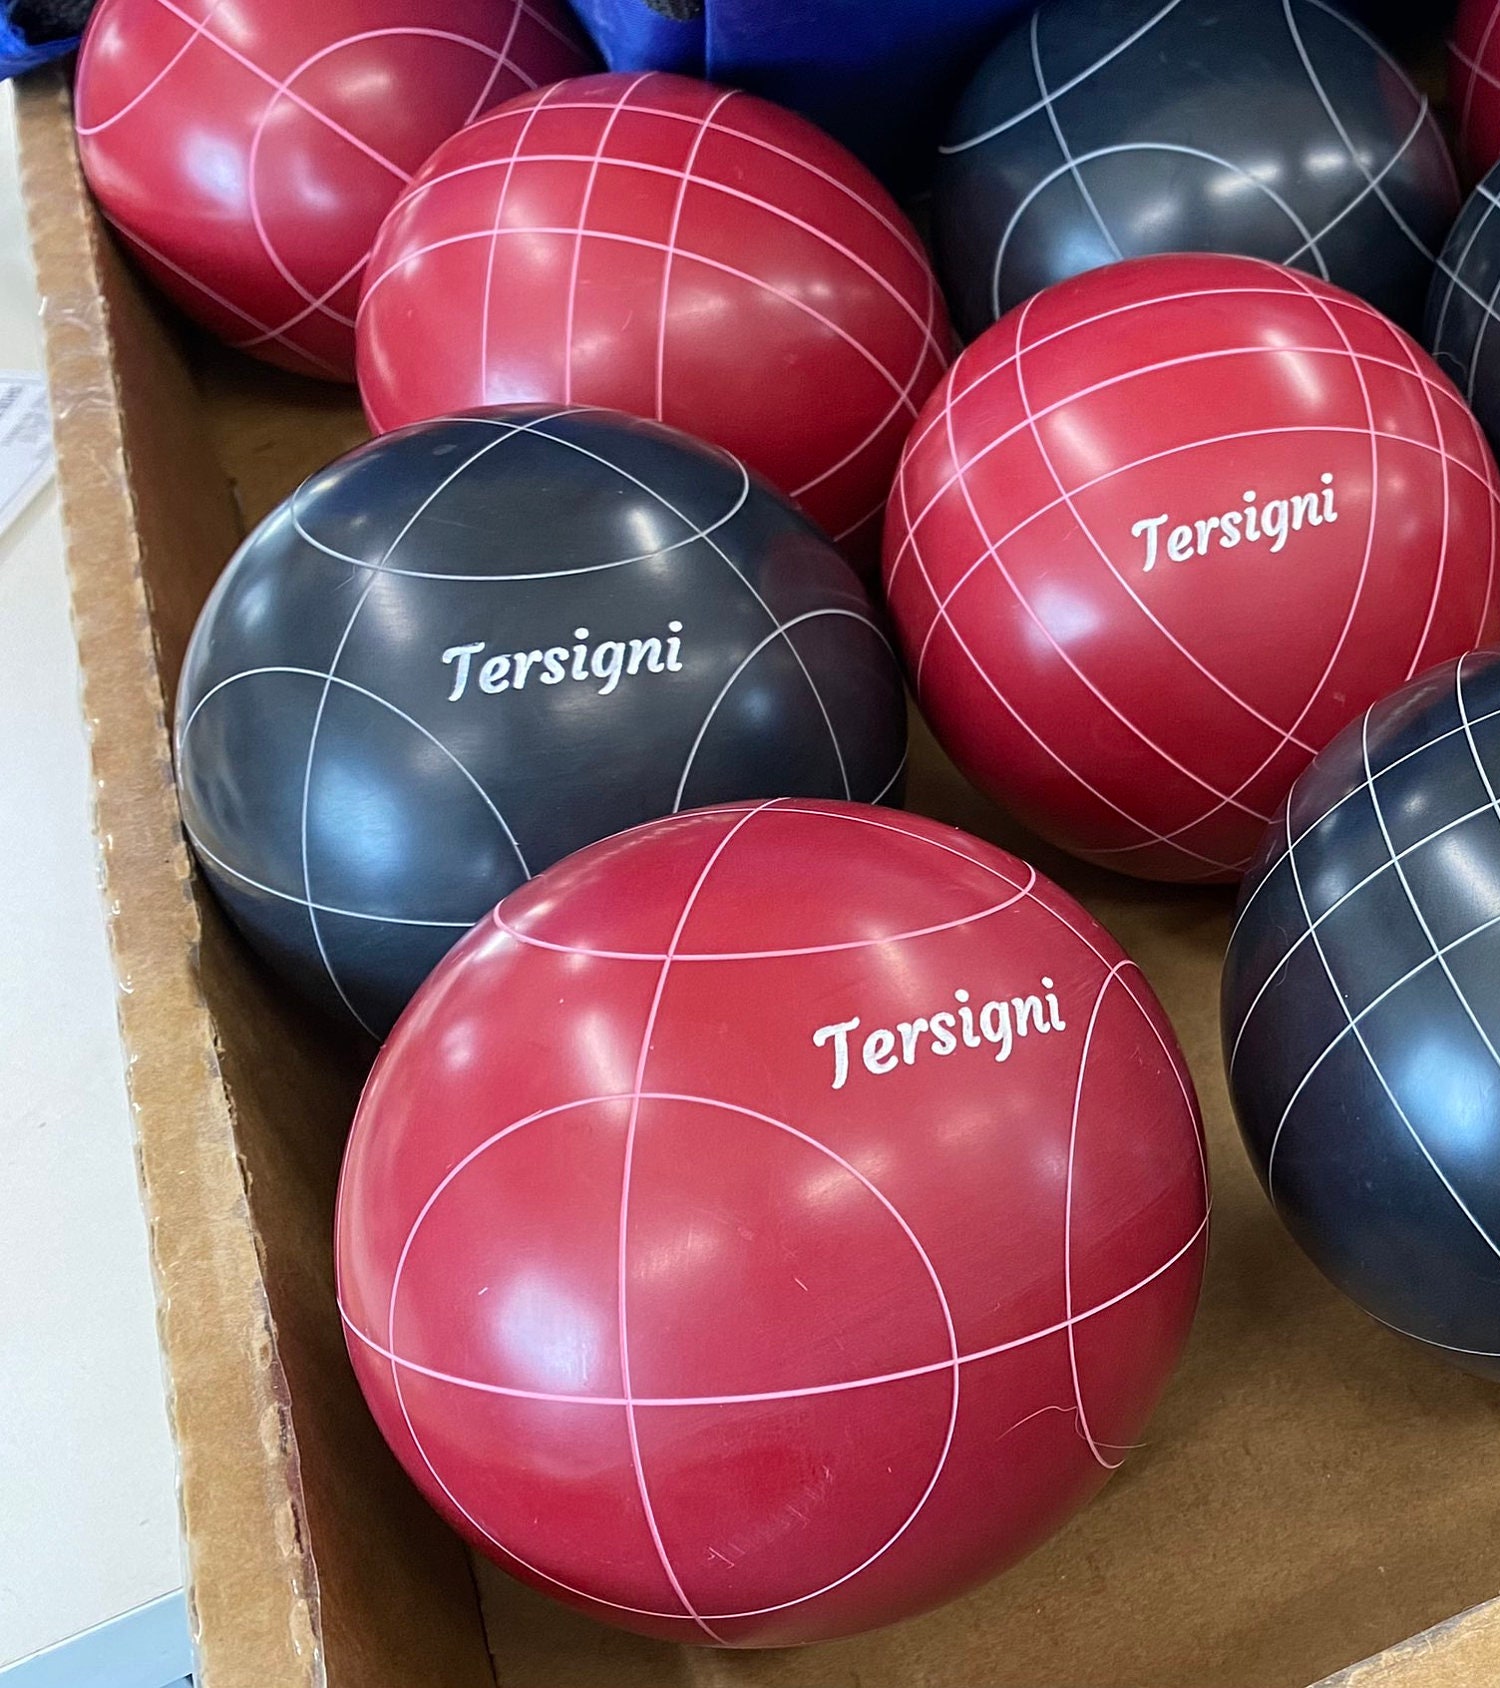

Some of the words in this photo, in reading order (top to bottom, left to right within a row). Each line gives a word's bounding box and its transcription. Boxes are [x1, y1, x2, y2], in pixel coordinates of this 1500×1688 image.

[1131, 472, 1338, 573] Tersigni
[441, 620, 683, 702] Tersigni
[812, 976, 1066, 1090] Tersigni
